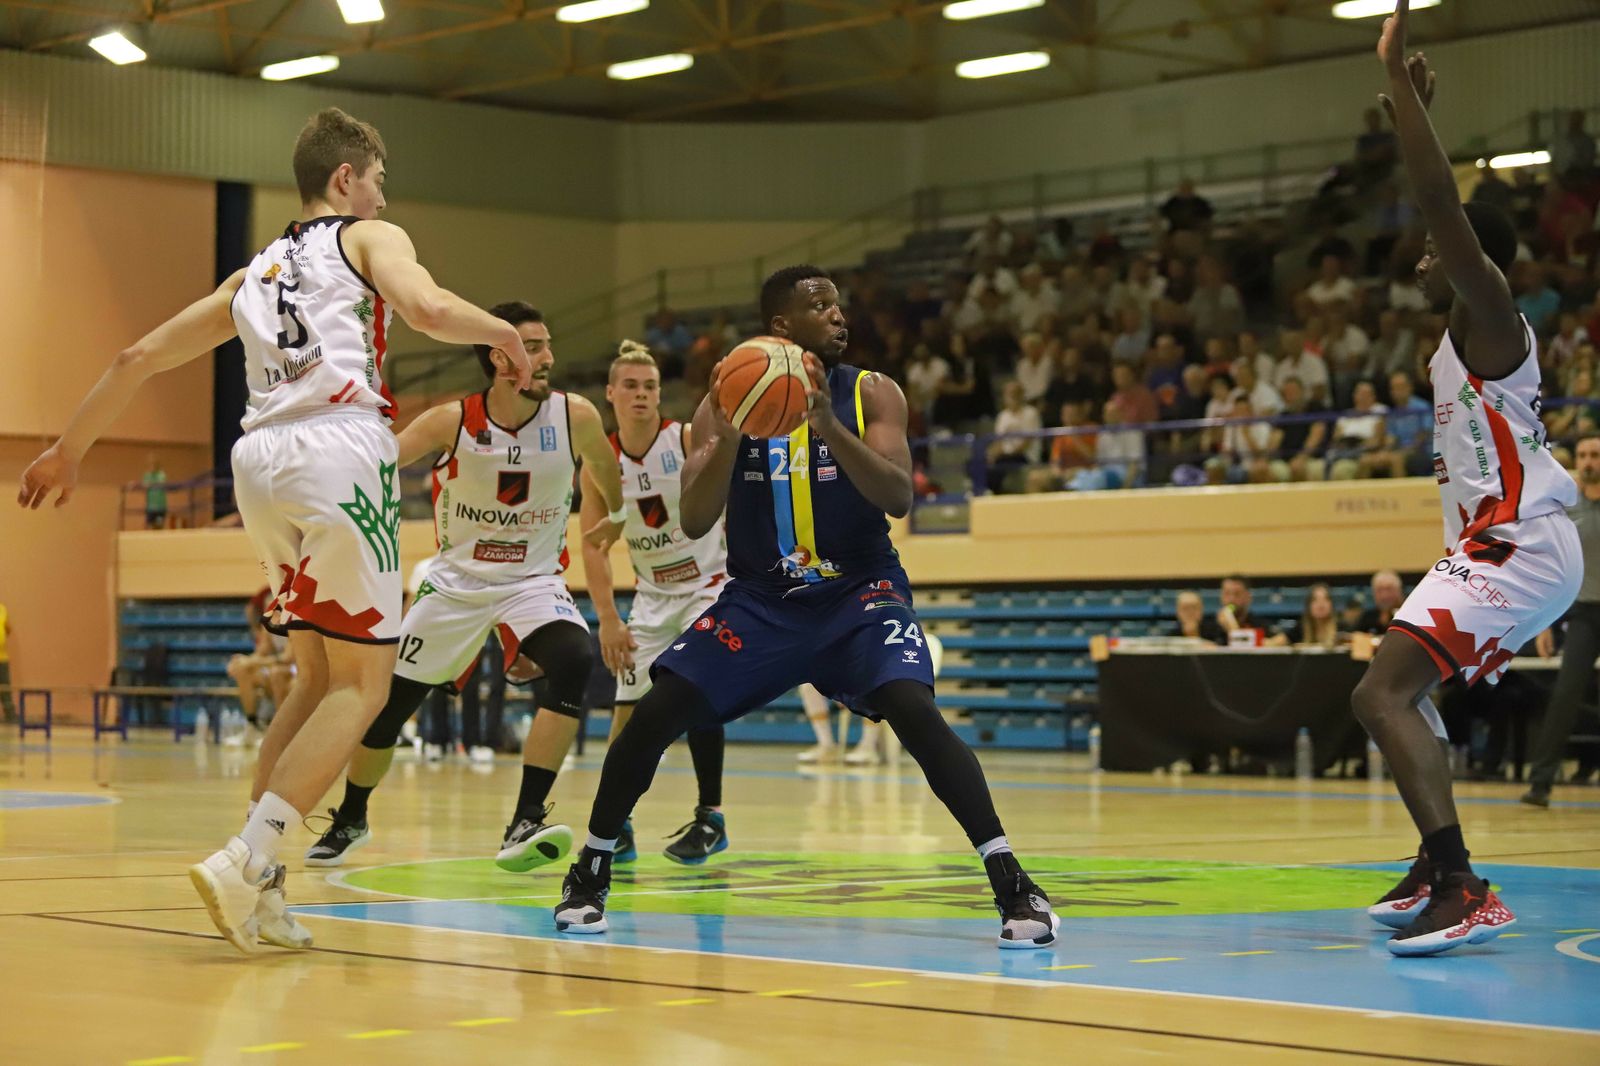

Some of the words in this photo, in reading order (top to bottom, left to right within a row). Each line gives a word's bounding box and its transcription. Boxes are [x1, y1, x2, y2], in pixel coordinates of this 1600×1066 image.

[277, 281, 309, 350] 5
[1468, 419, 1482, 443] CAJA
[507, 445, 522, 465] 12
[769, 446, 809, 481] 24
[637, 472, 651, 492] 13
[456, 502, 561, 526] INNOVACHEF
[483, 550, 524, 561] ZAMORA
[882, 619, 923, 648] 24
[398, 633, 425, 665] 12
